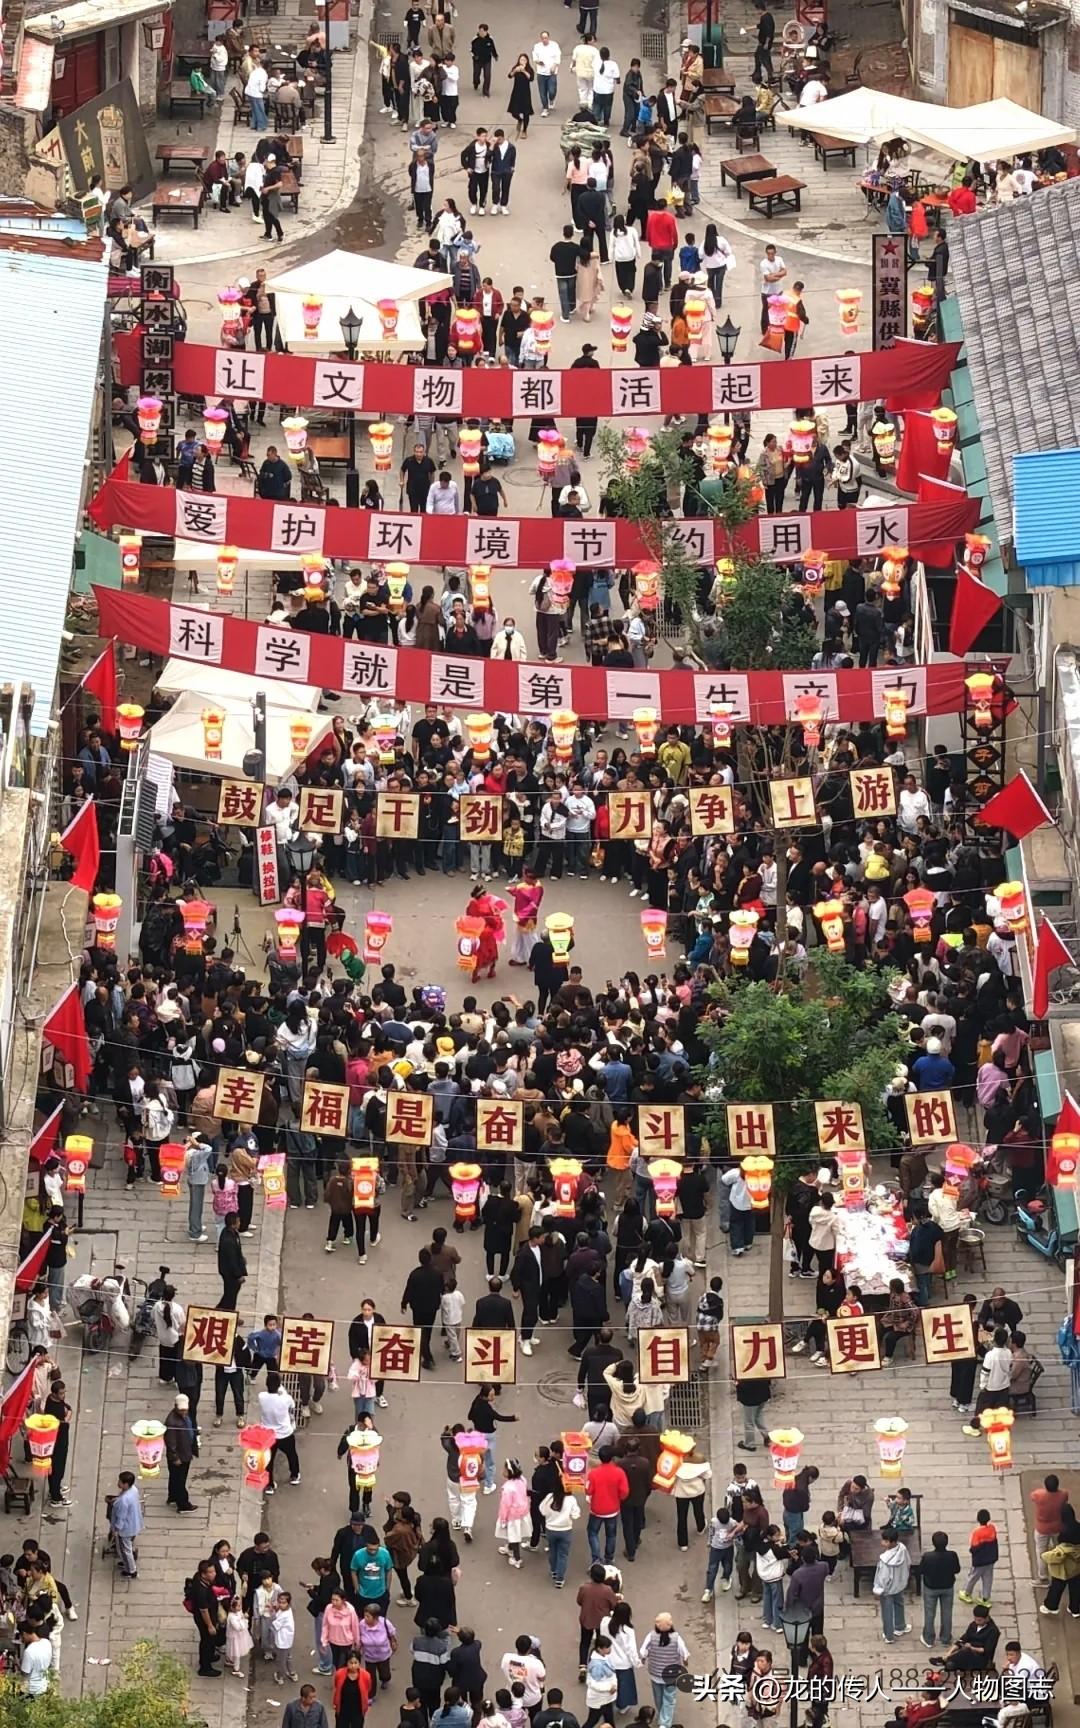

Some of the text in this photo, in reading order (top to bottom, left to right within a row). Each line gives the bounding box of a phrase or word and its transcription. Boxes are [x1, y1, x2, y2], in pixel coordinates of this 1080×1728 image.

[221, 358, 853, 410] 让文物都活起来
